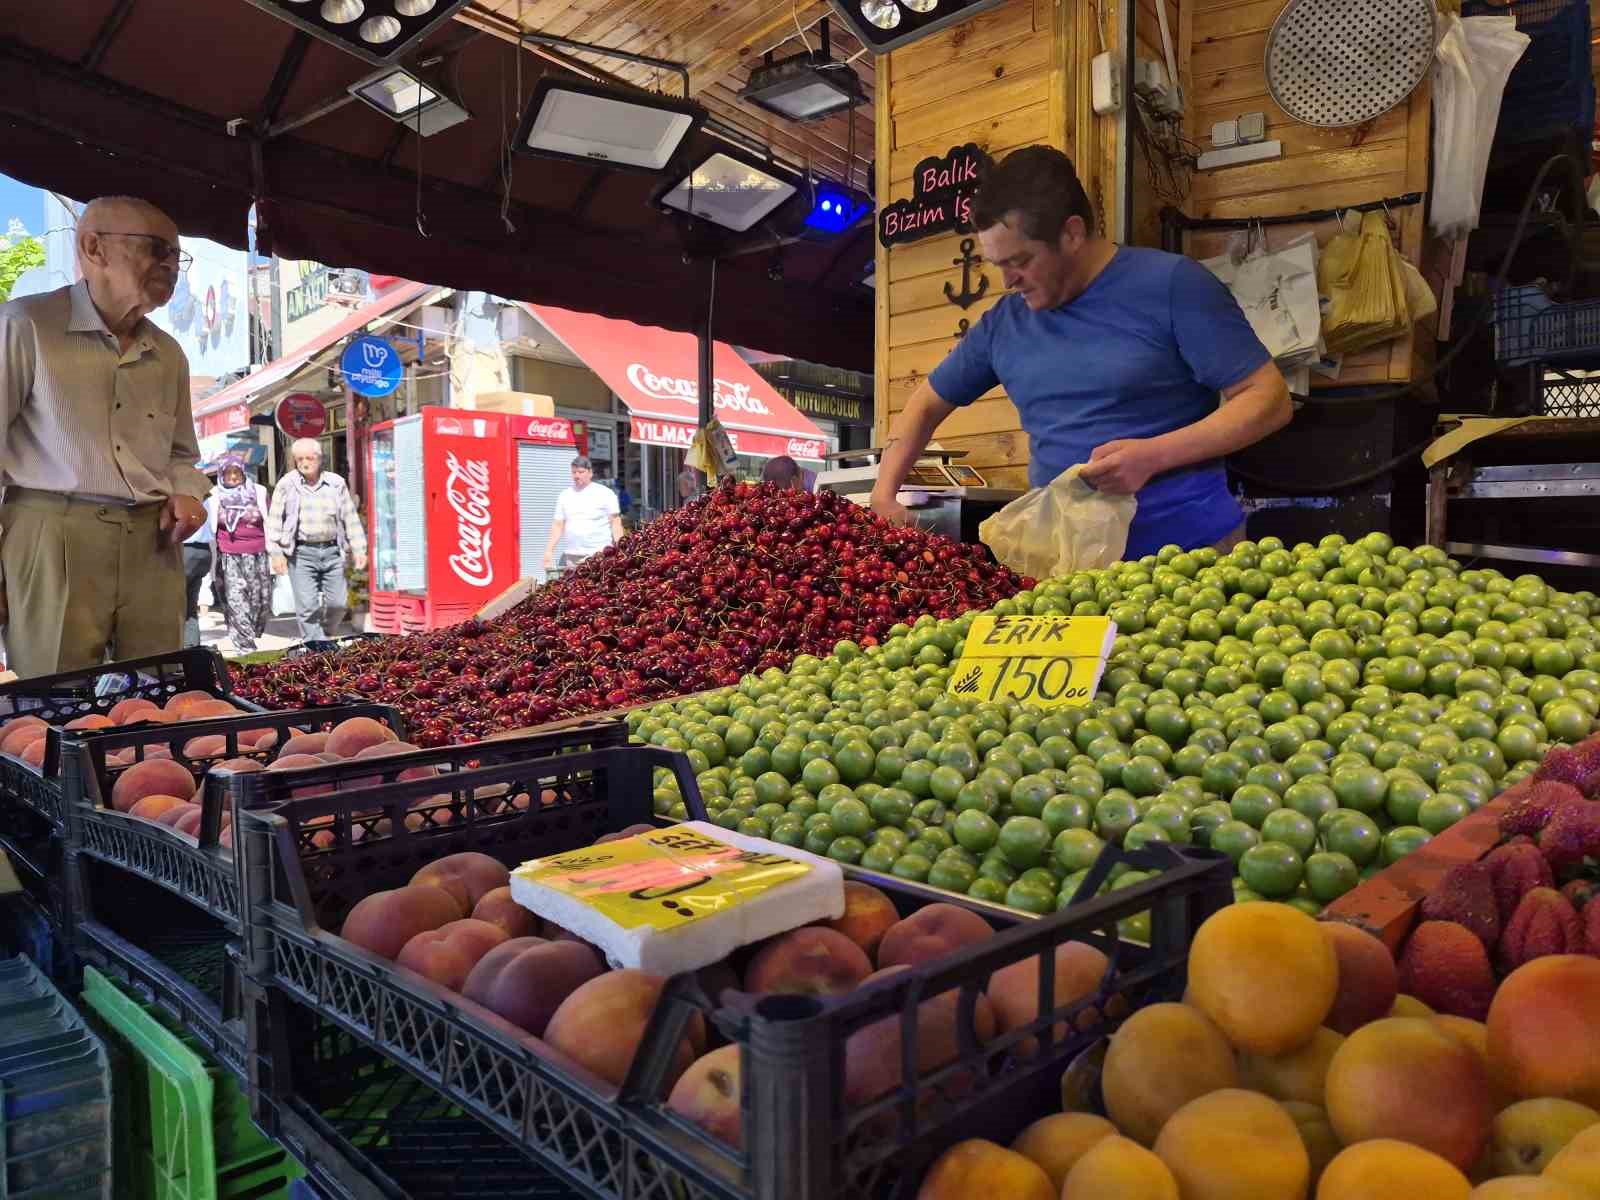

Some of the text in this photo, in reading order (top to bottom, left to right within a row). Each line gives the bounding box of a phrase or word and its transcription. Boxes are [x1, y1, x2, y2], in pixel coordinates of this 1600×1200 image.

[922, 156, 977, 193] Balık
[885, 188, 978, 236] Bizim İş
[446, 450, 493, 587] Coca-Cola
